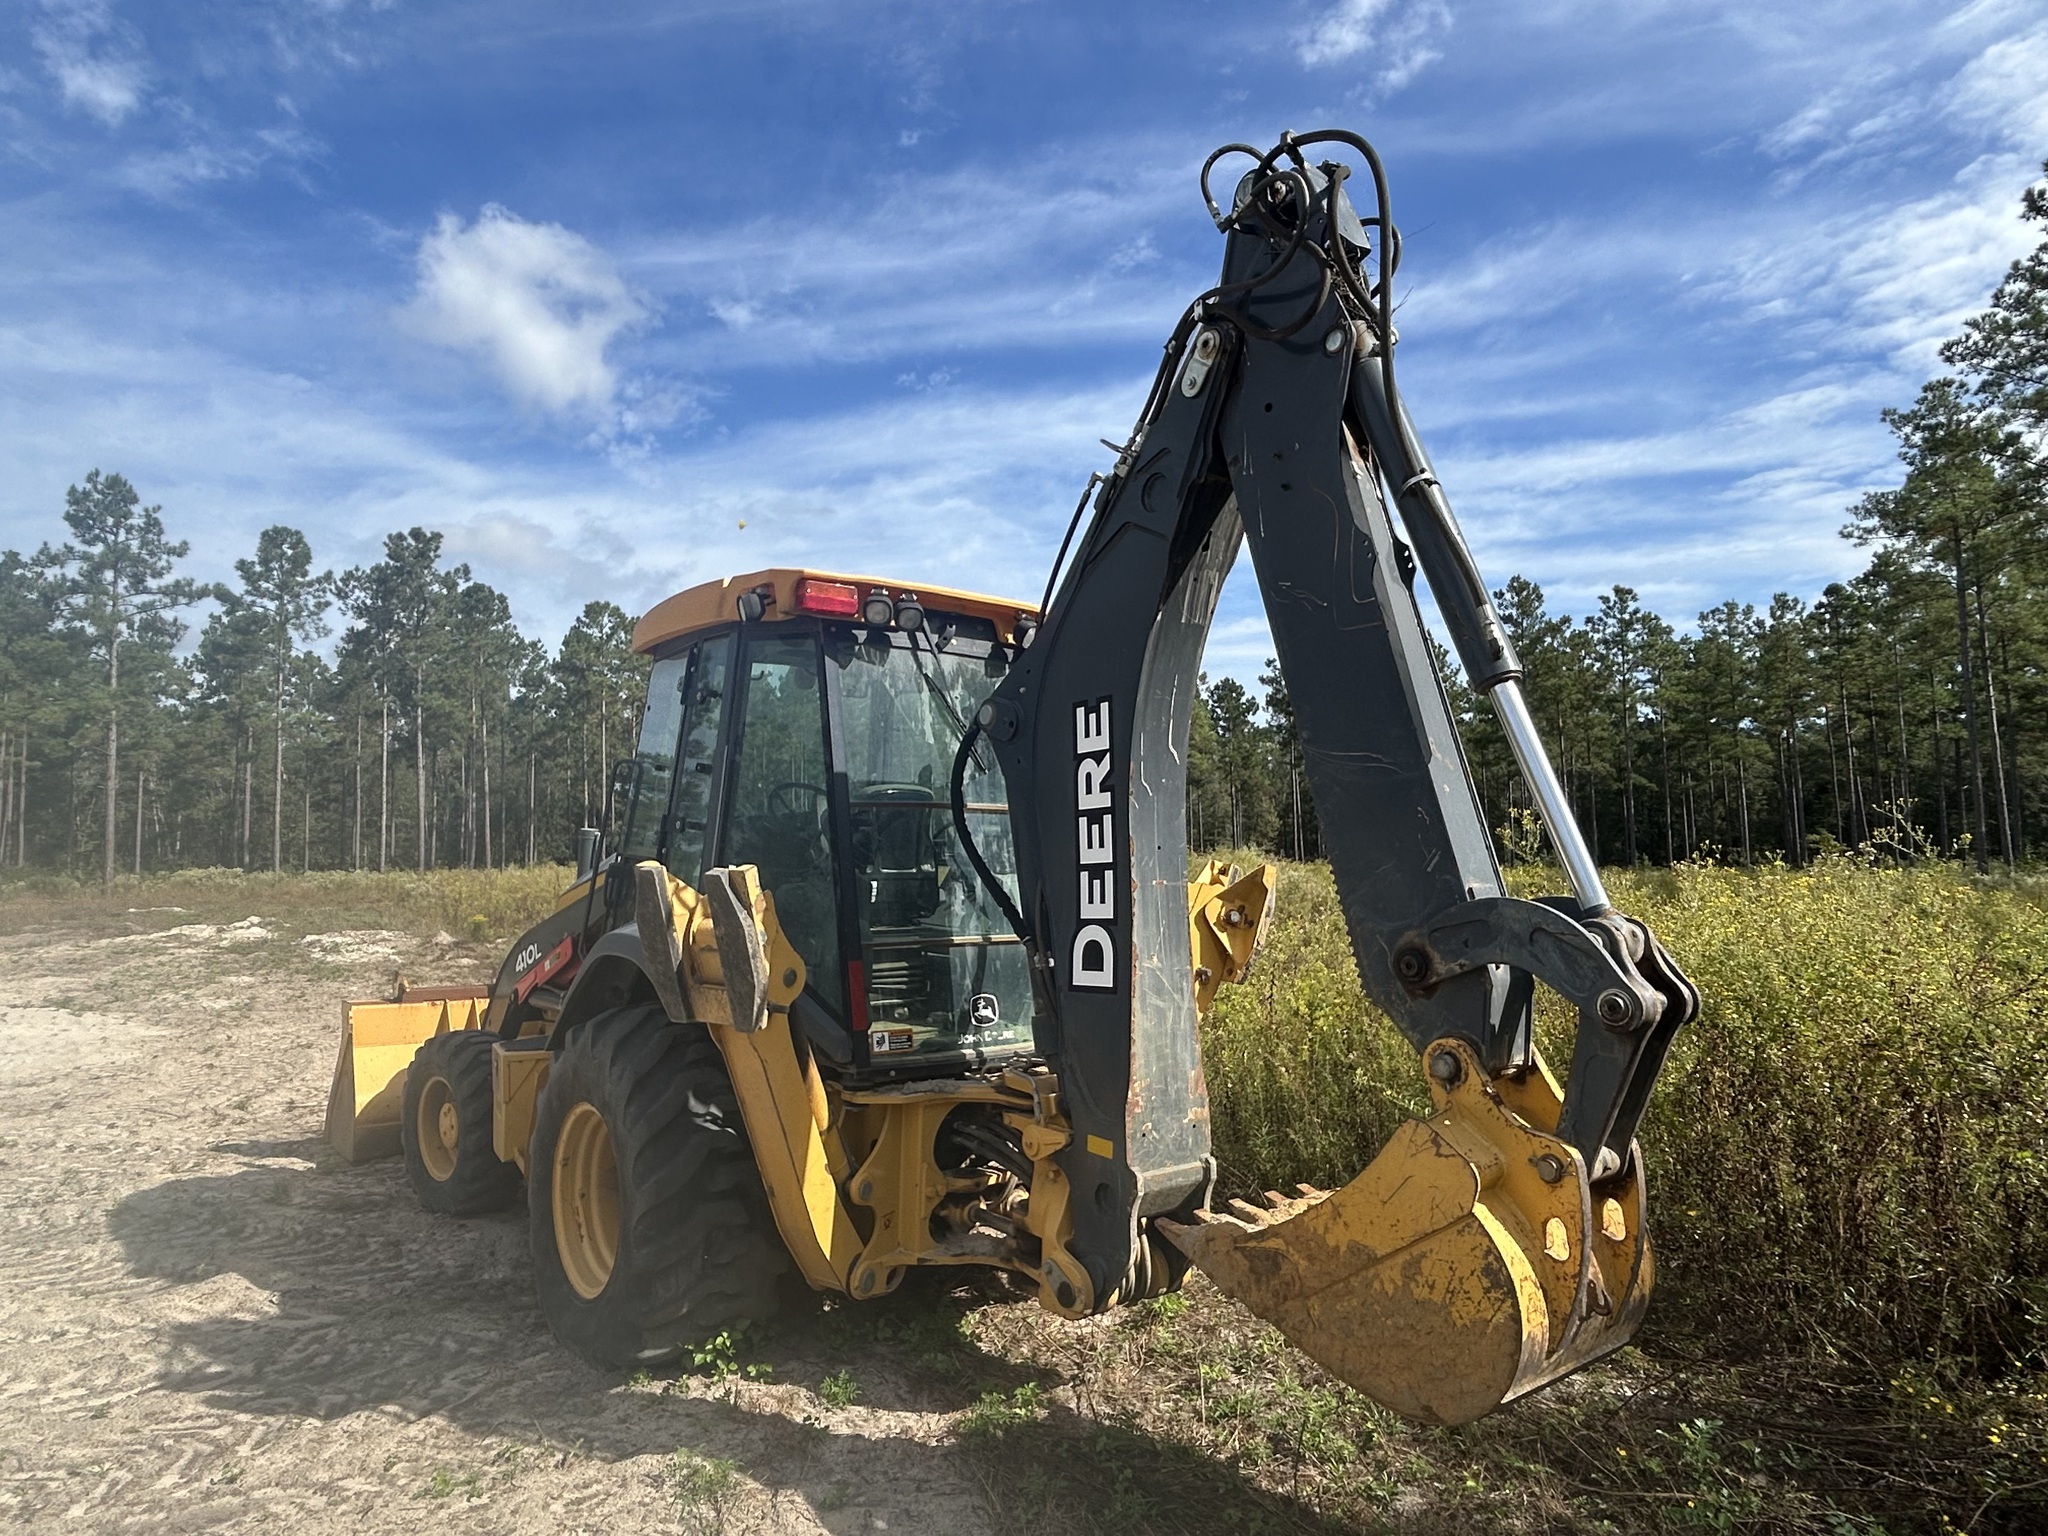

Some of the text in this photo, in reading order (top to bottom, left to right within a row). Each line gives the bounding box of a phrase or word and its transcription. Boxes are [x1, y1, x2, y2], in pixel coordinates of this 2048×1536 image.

[1073, 701, 1114, 988] DEERE
[515, 943, 542, 972] 410L
[958, 1033, 984, 1045] JOHN
